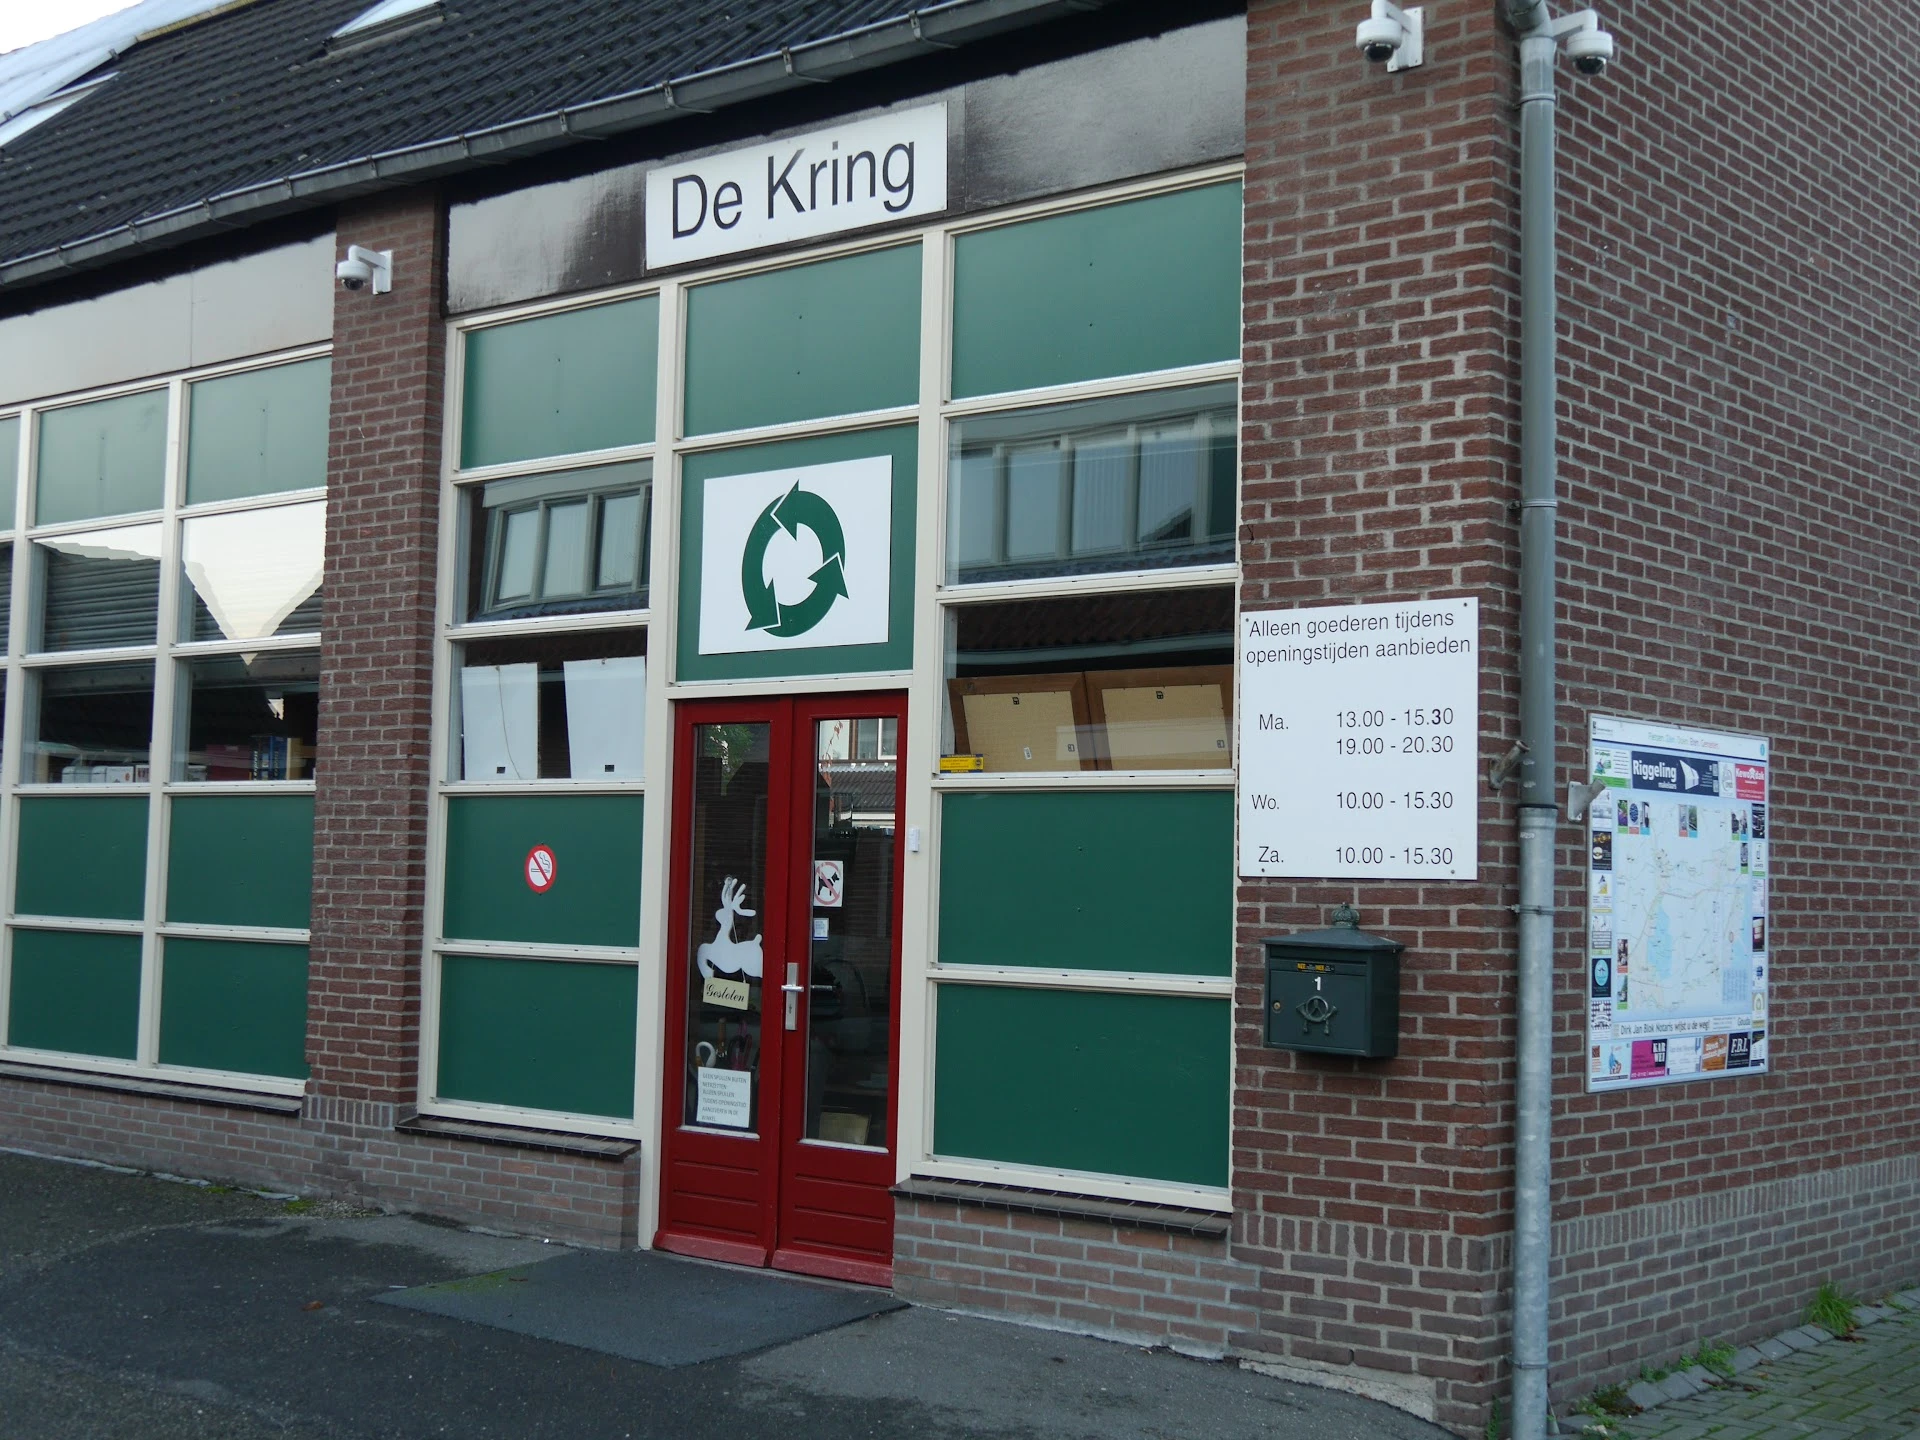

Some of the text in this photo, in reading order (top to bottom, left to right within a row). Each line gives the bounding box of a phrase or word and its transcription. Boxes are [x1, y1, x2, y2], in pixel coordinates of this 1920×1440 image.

[672, 141, 915, 239] De Kring
[1249, 611, 1455, 638] Alleen goederen tijdens
[1246, 637, 1471, 667] openingstijden aanbieden
[1258, 713, 1289, 731] Ma.
[1336, 710, 1385, 728] 13.00
[1404, 708, 1454, 726] 15.30
[1336, 737, 1385, 755] 19.00
[1402, 735, 1454, 754] 20.30
[1633, 759, 1677, 783] Riggeling
[1251, 793, 1280, 811] Wo.
[1336, 791, 1385, 809] 10.00
[1403, 791, 1454, 809] 15.30
[1258, 846, 1285, 864] Za.
[1336, 846, 1384, 865] 10.00
[1403, 846, 1454, 865] 15.30
[705, 983, 746, 1003] Gesloten
[1314, 976, 1322, 991] 1
[1620, 1025, 1632, 1035] Dirk
[1632, 1024, 1643, 1034] Jan
[1643, 1023, 1654, 1033] Blok
[1655, 1022, 1673, 1033] Notaris
[1674, 1021, 1686, 1032] wijst
[1692, 1021, 1698, 1030] de
[1731, 1037, 1749, 1053] F.B.I.
